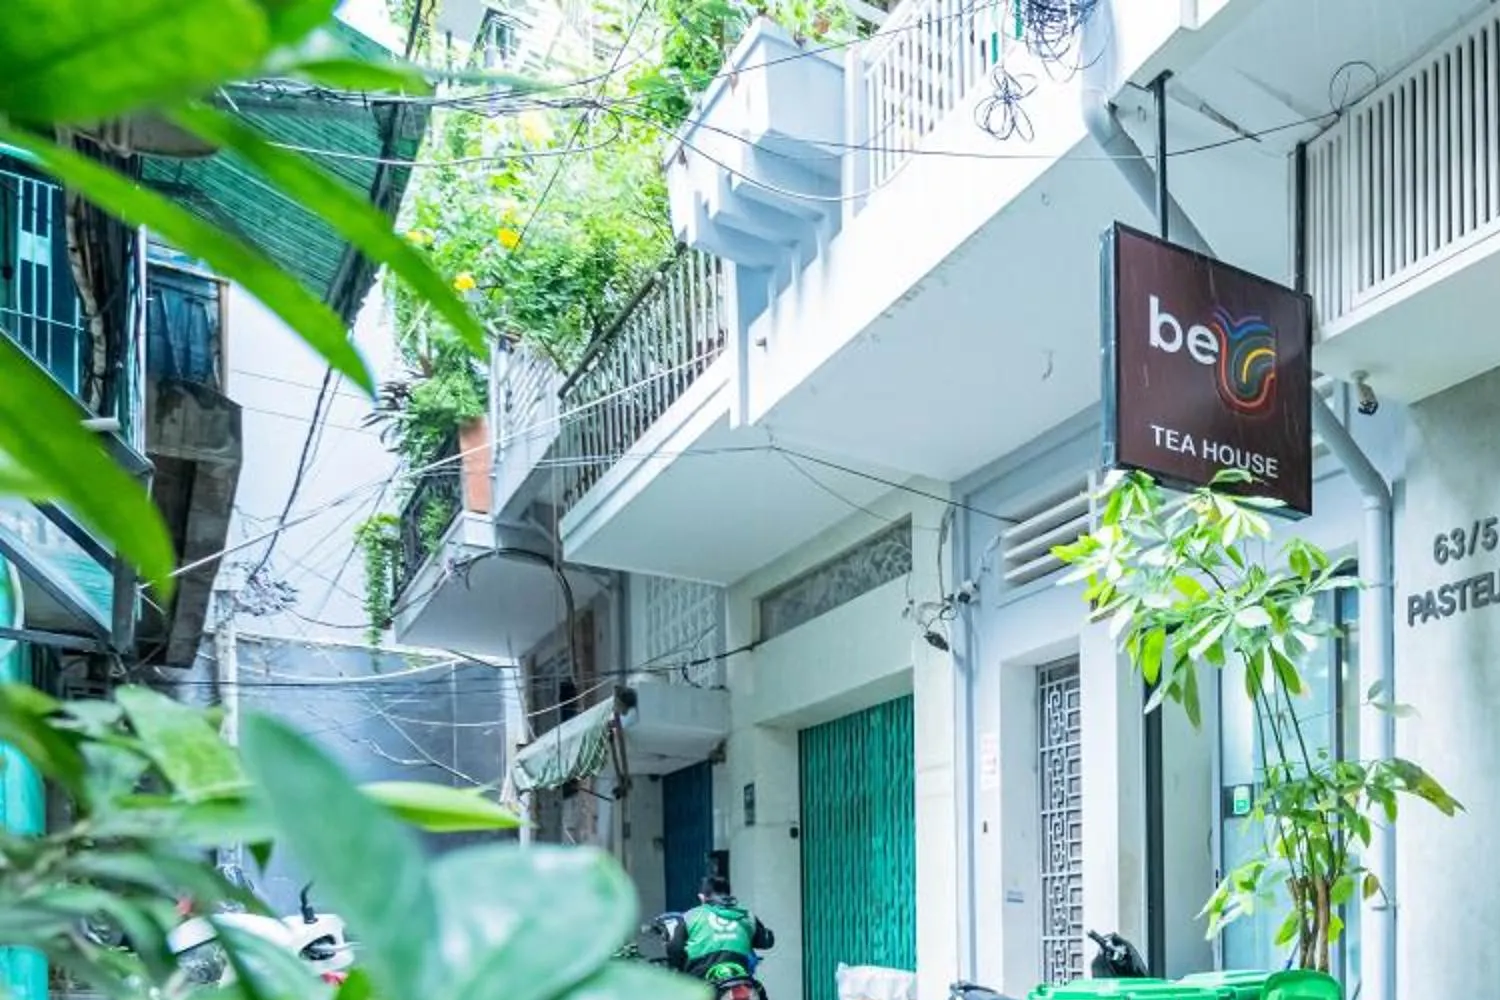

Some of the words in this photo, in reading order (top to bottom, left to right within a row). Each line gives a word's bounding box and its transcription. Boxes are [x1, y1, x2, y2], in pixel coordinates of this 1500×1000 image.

[1151, 425, 1196, 456] TEA
[1203, 440, 1279, 478] HOUSE
[1433, 517, 1498, 565] 63/5
